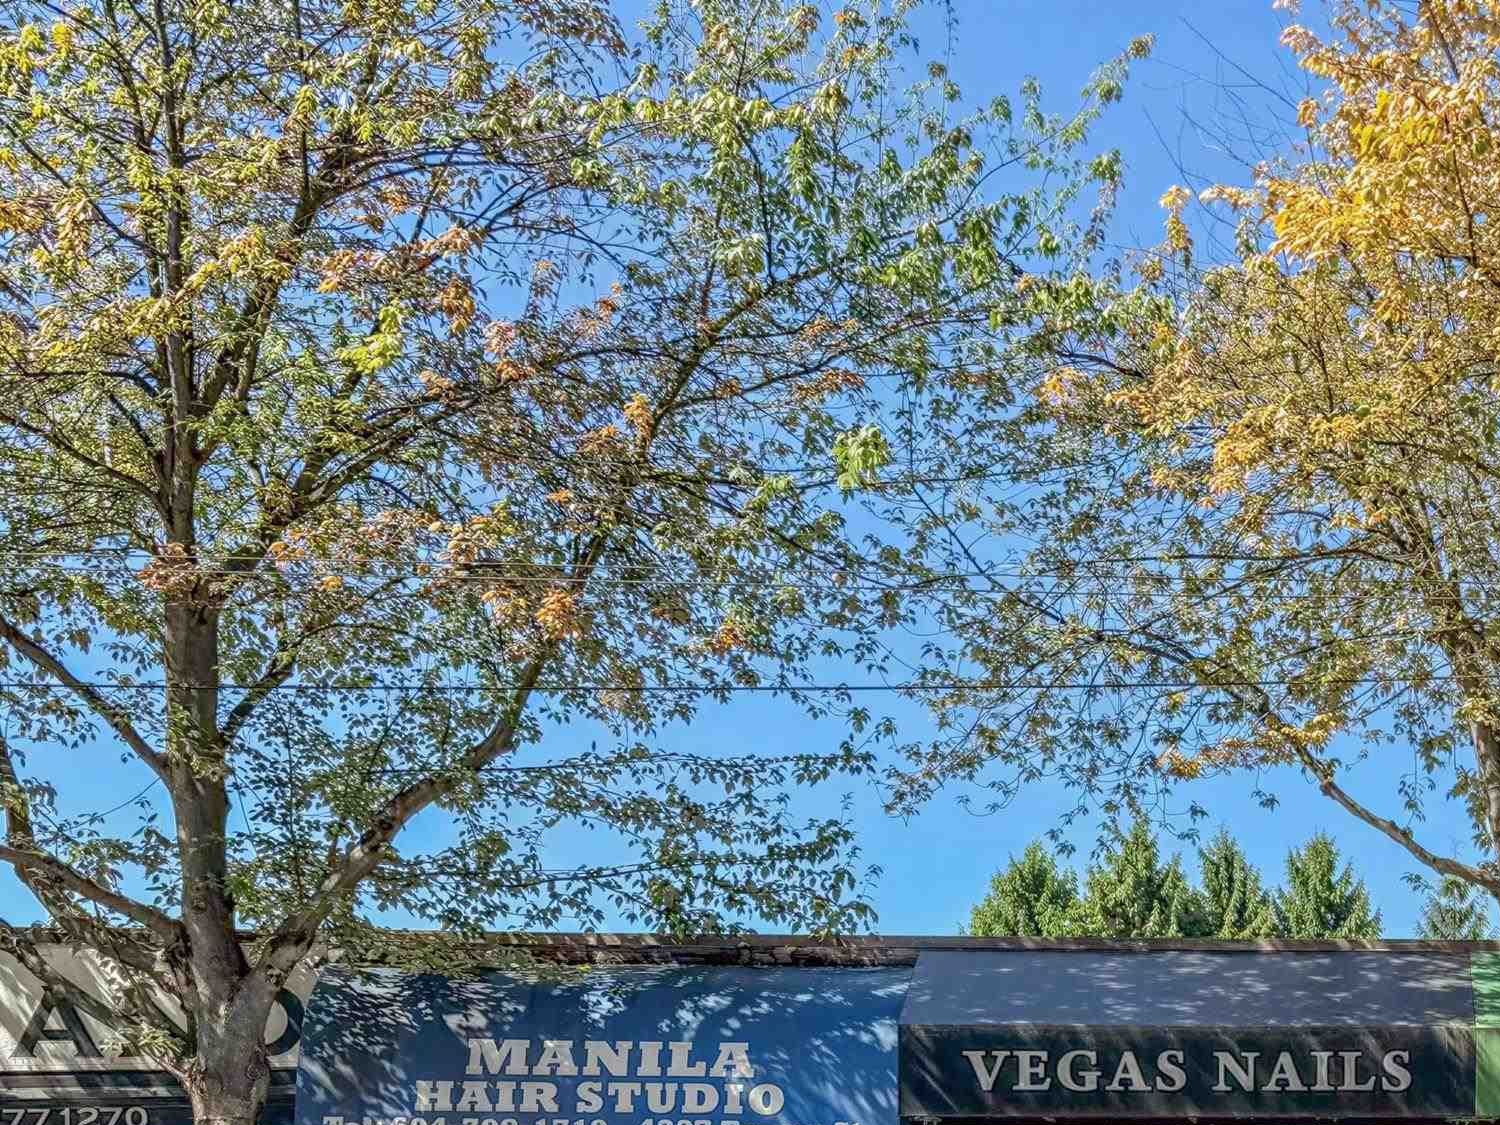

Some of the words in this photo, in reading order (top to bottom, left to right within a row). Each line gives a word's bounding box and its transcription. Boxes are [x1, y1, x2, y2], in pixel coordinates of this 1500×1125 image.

[465, 1038, 754, 1077] MANILA
[962, 1050, 1187, 1092] VEGAS
[1212, 1050, 1413, 1092] NAILS
[415, 1081, 559, 1113] HAIR
[576, 1081, 785, 1116] STUDIO
